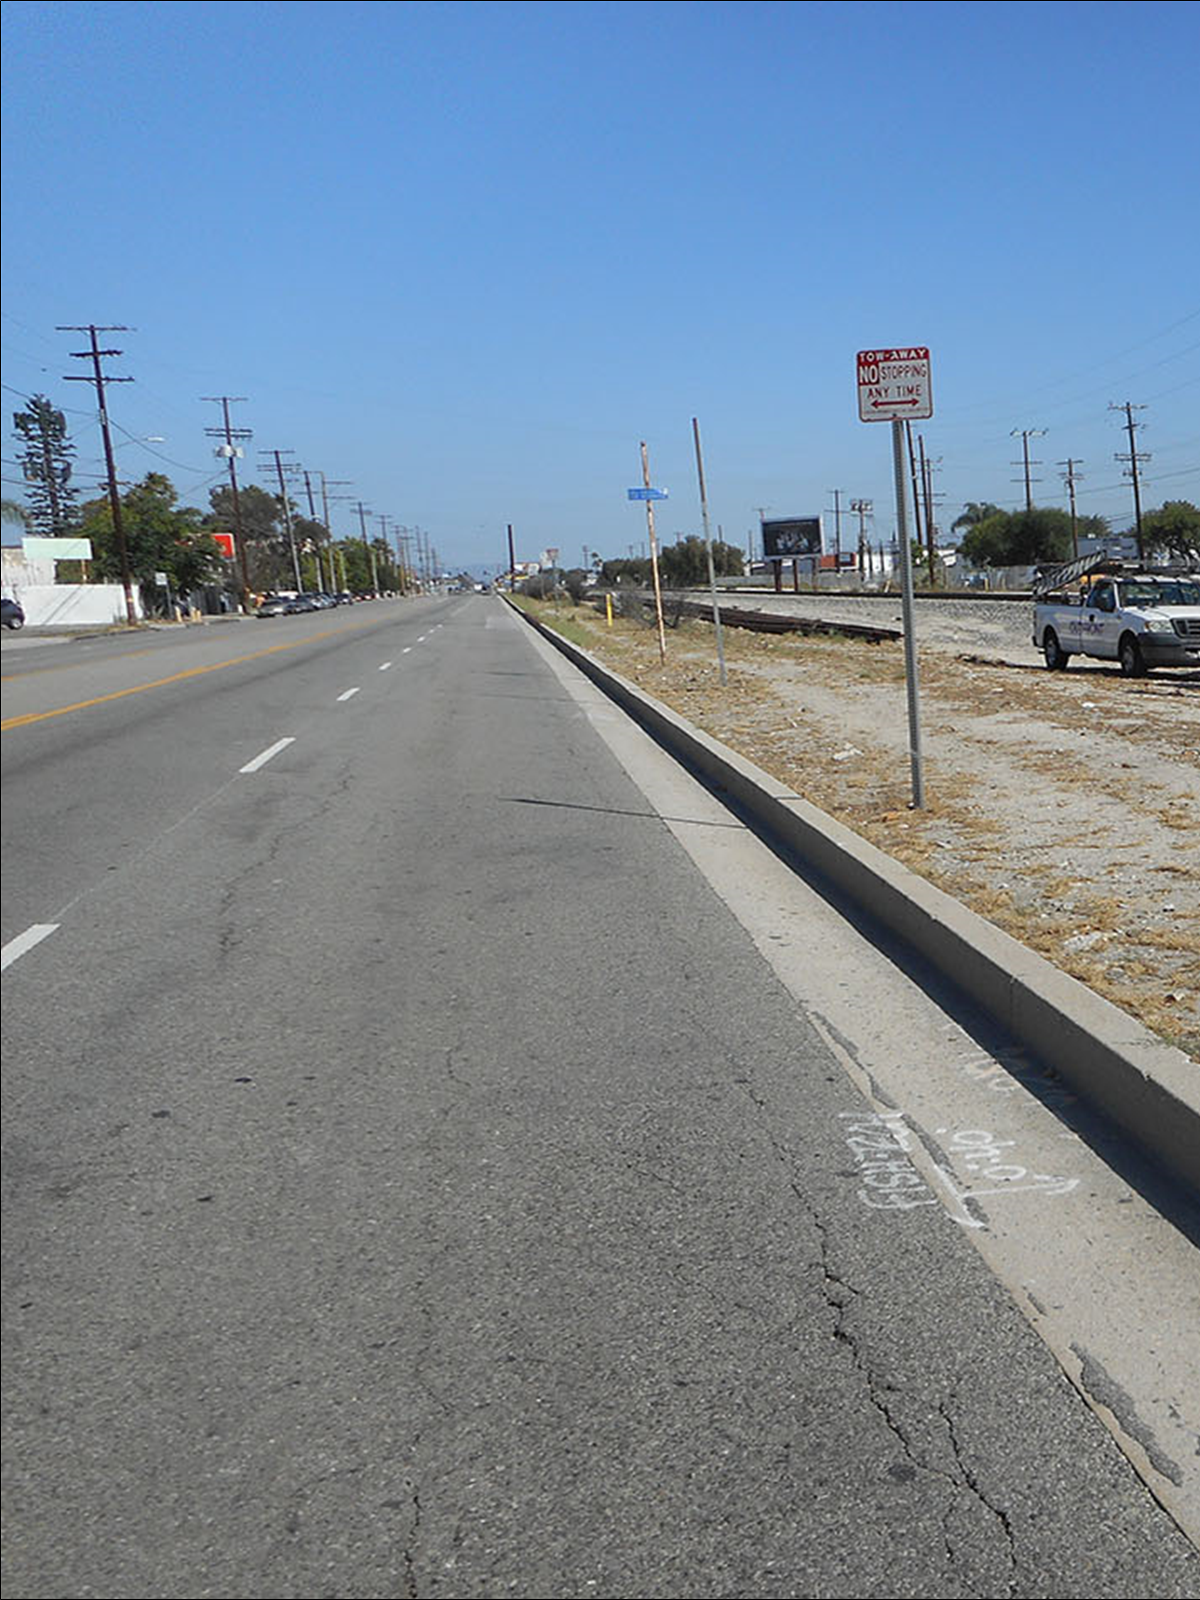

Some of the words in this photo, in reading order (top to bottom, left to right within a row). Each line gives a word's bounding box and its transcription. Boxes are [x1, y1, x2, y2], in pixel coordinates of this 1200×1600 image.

[860, 349, 926, 362] TOW-AWAY
[859, 364, 878, 383] NO
[881, 363, 927, 380] STOPPING
[867, 386, 889, 398] ANY
[897, 384, 921, 397] TIME
